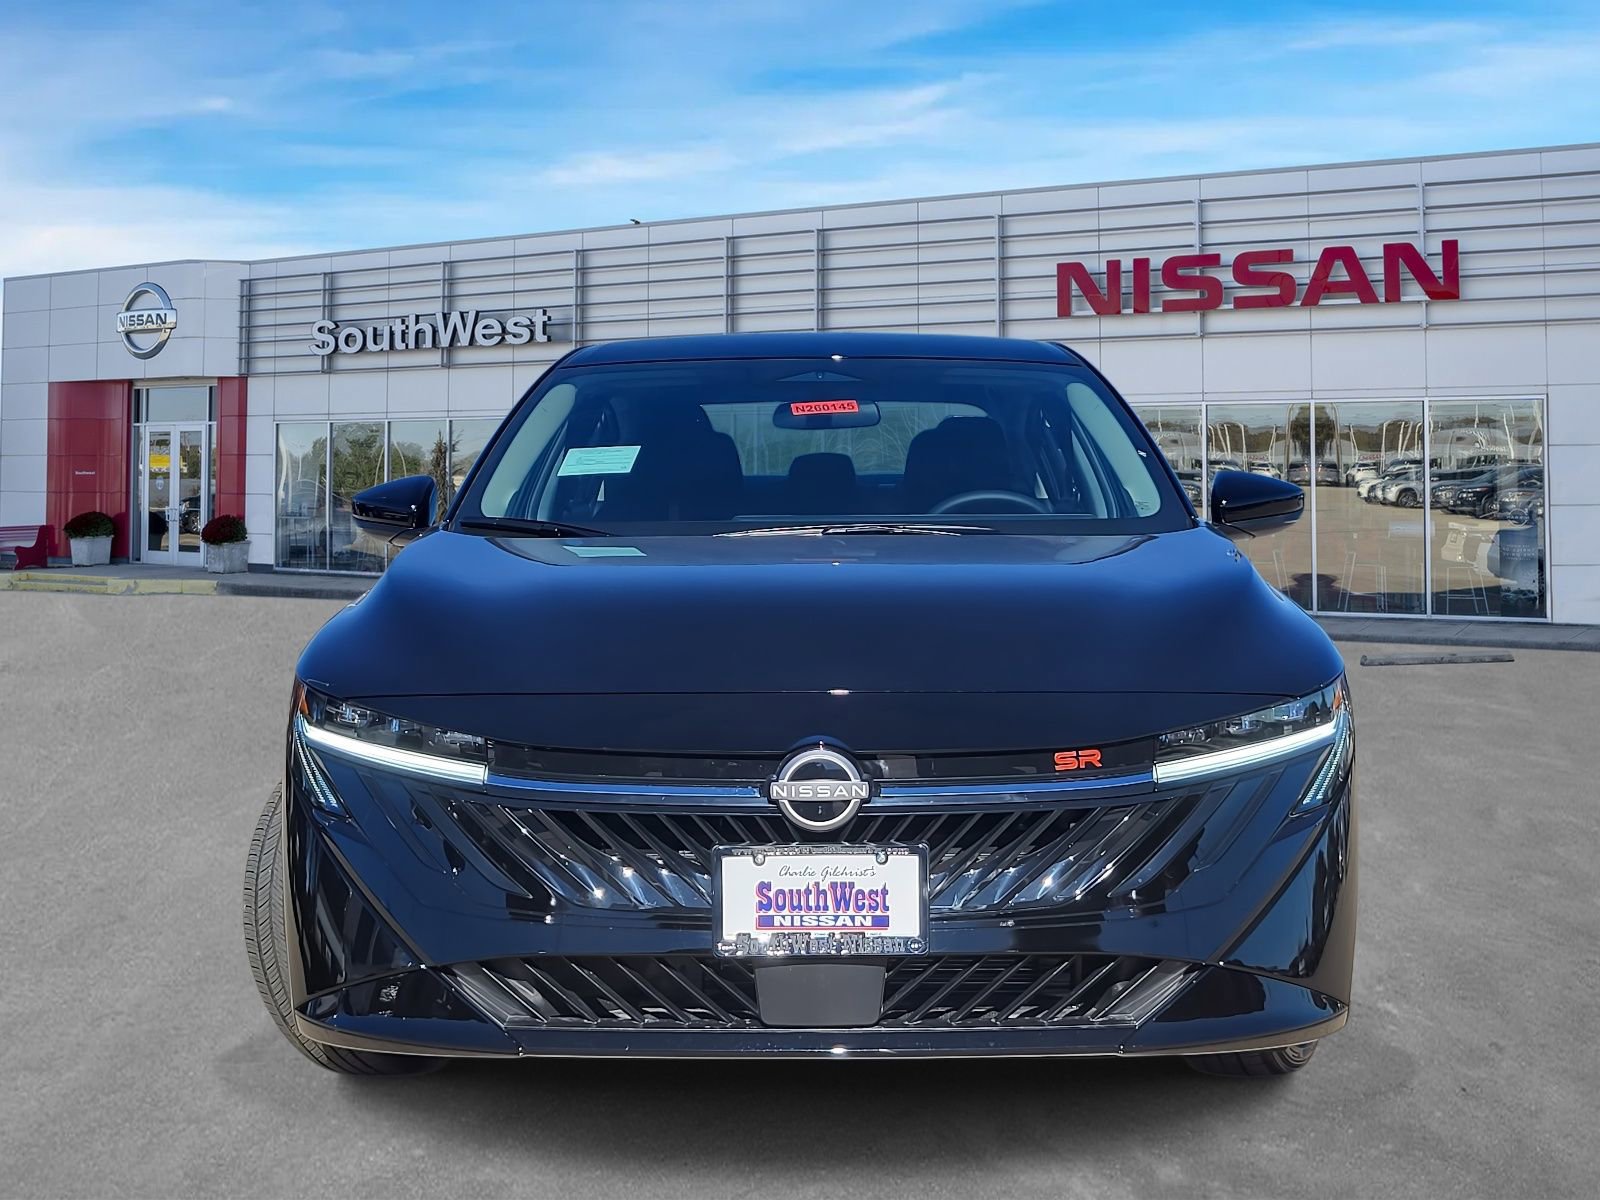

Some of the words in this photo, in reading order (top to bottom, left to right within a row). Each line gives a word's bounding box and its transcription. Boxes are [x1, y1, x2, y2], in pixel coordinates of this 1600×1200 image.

[1057, 239, 1460, 317] NISSAN
[119, 312, 167, 328] NISSAN
[308, 308, 551, 356] SouthWest
[795, 402, 855, 413] N260145
[1054, 749, 1102, 771] SR
[772, 784, 868, 798] NISSAN
[779, 865, 817, 877] Charlie
[821, 865, 876, 882] Gilchrist's
[756, 881, 890, 913] SouthWest
[773, 914, 873, 928] NISSAN
